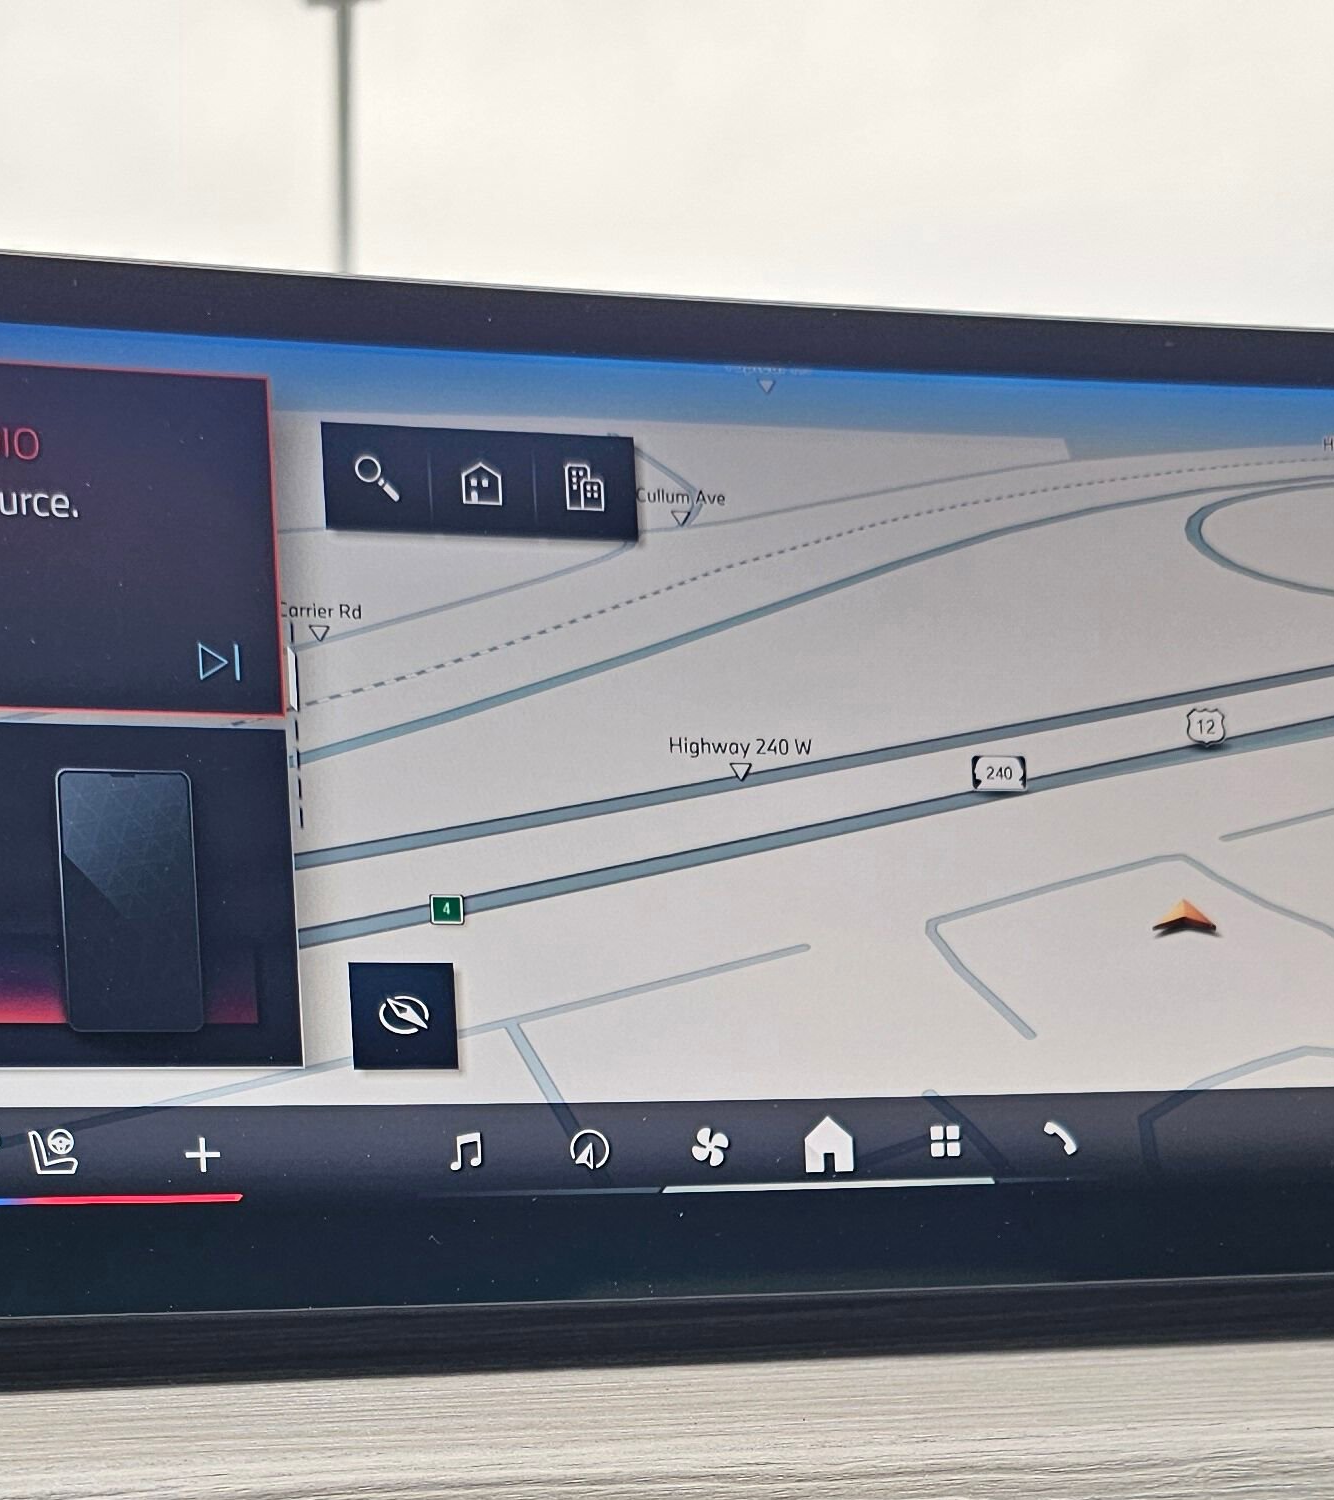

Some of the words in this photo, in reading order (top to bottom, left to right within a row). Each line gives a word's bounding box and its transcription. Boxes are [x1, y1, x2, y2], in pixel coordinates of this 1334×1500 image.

[636, 487, 690, 504] Cullum
[695, 489, 726, 506] Ave
[339, 603, 362, 619] Rd
[1197, 718, 1216, 735] 12
[669, 736, 751, 759] Highway
[756, 738, 789, 755] 240
[794, 738, 812, 755] W
[985, 766, 1013, 781] 240
[442, 901, 450, 915] 4
